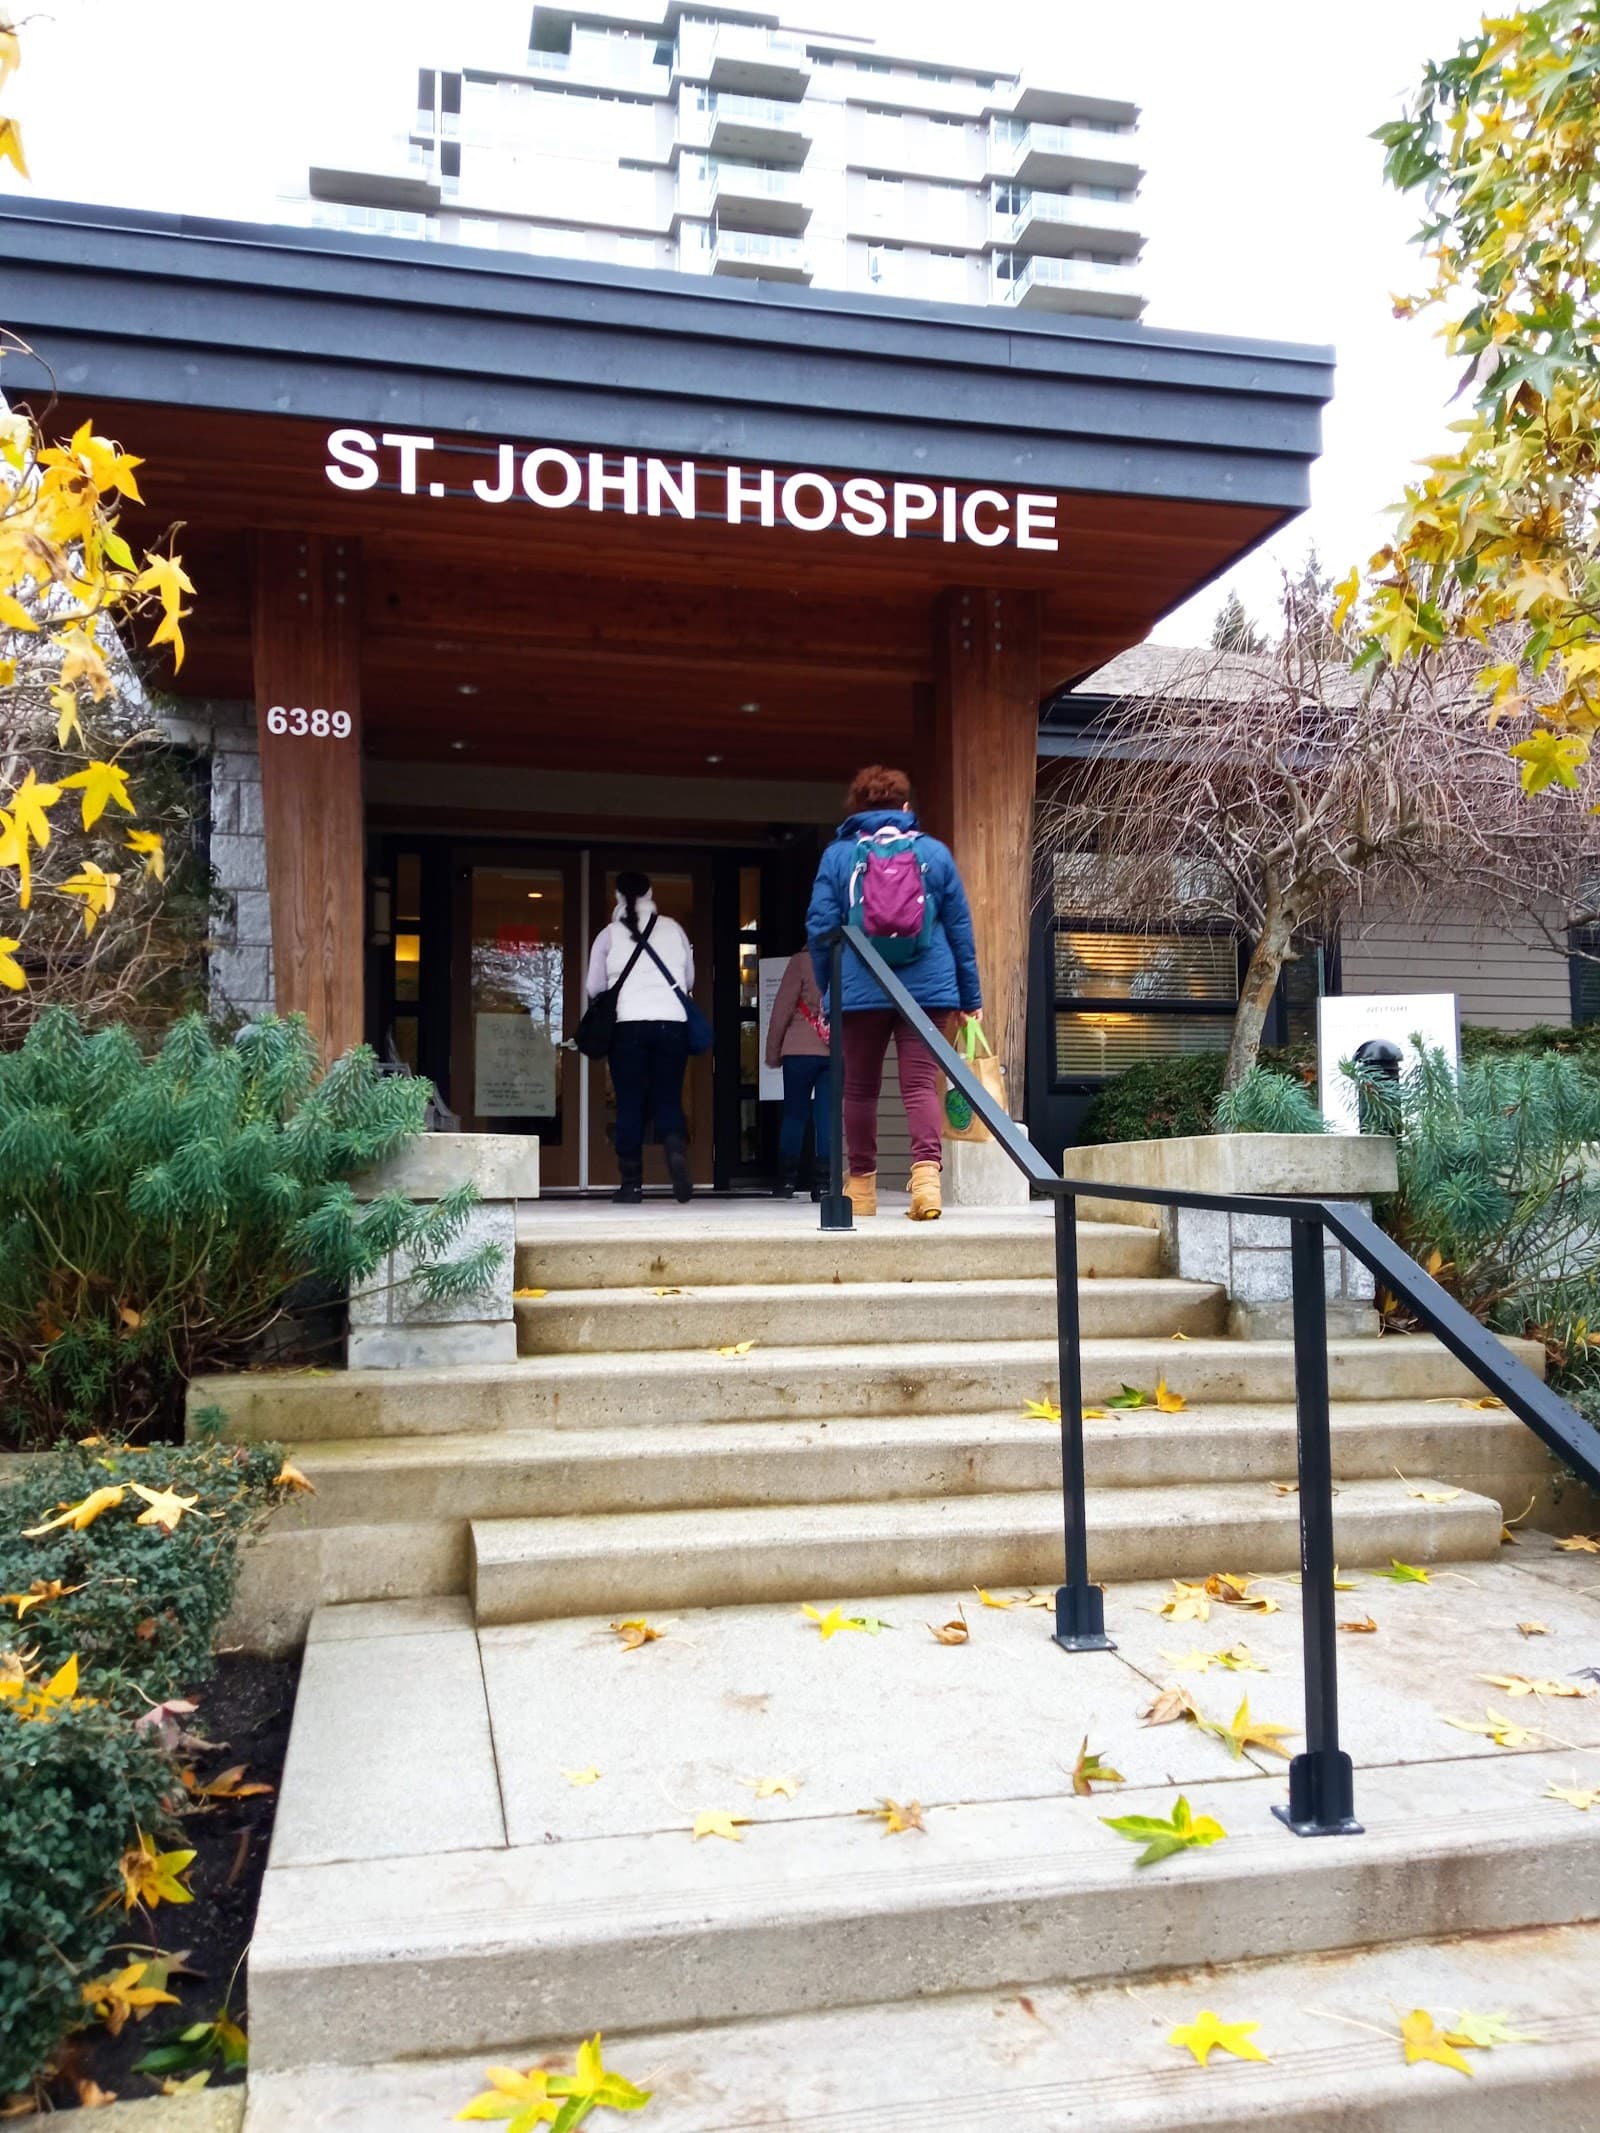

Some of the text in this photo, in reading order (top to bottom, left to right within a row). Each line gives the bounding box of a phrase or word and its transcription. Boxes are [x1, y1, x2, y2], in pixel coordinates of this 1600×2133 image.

[325, 428, 1060, 552] ST. JOHN HOSPICE
[267, 706, 352, 739] 6389
